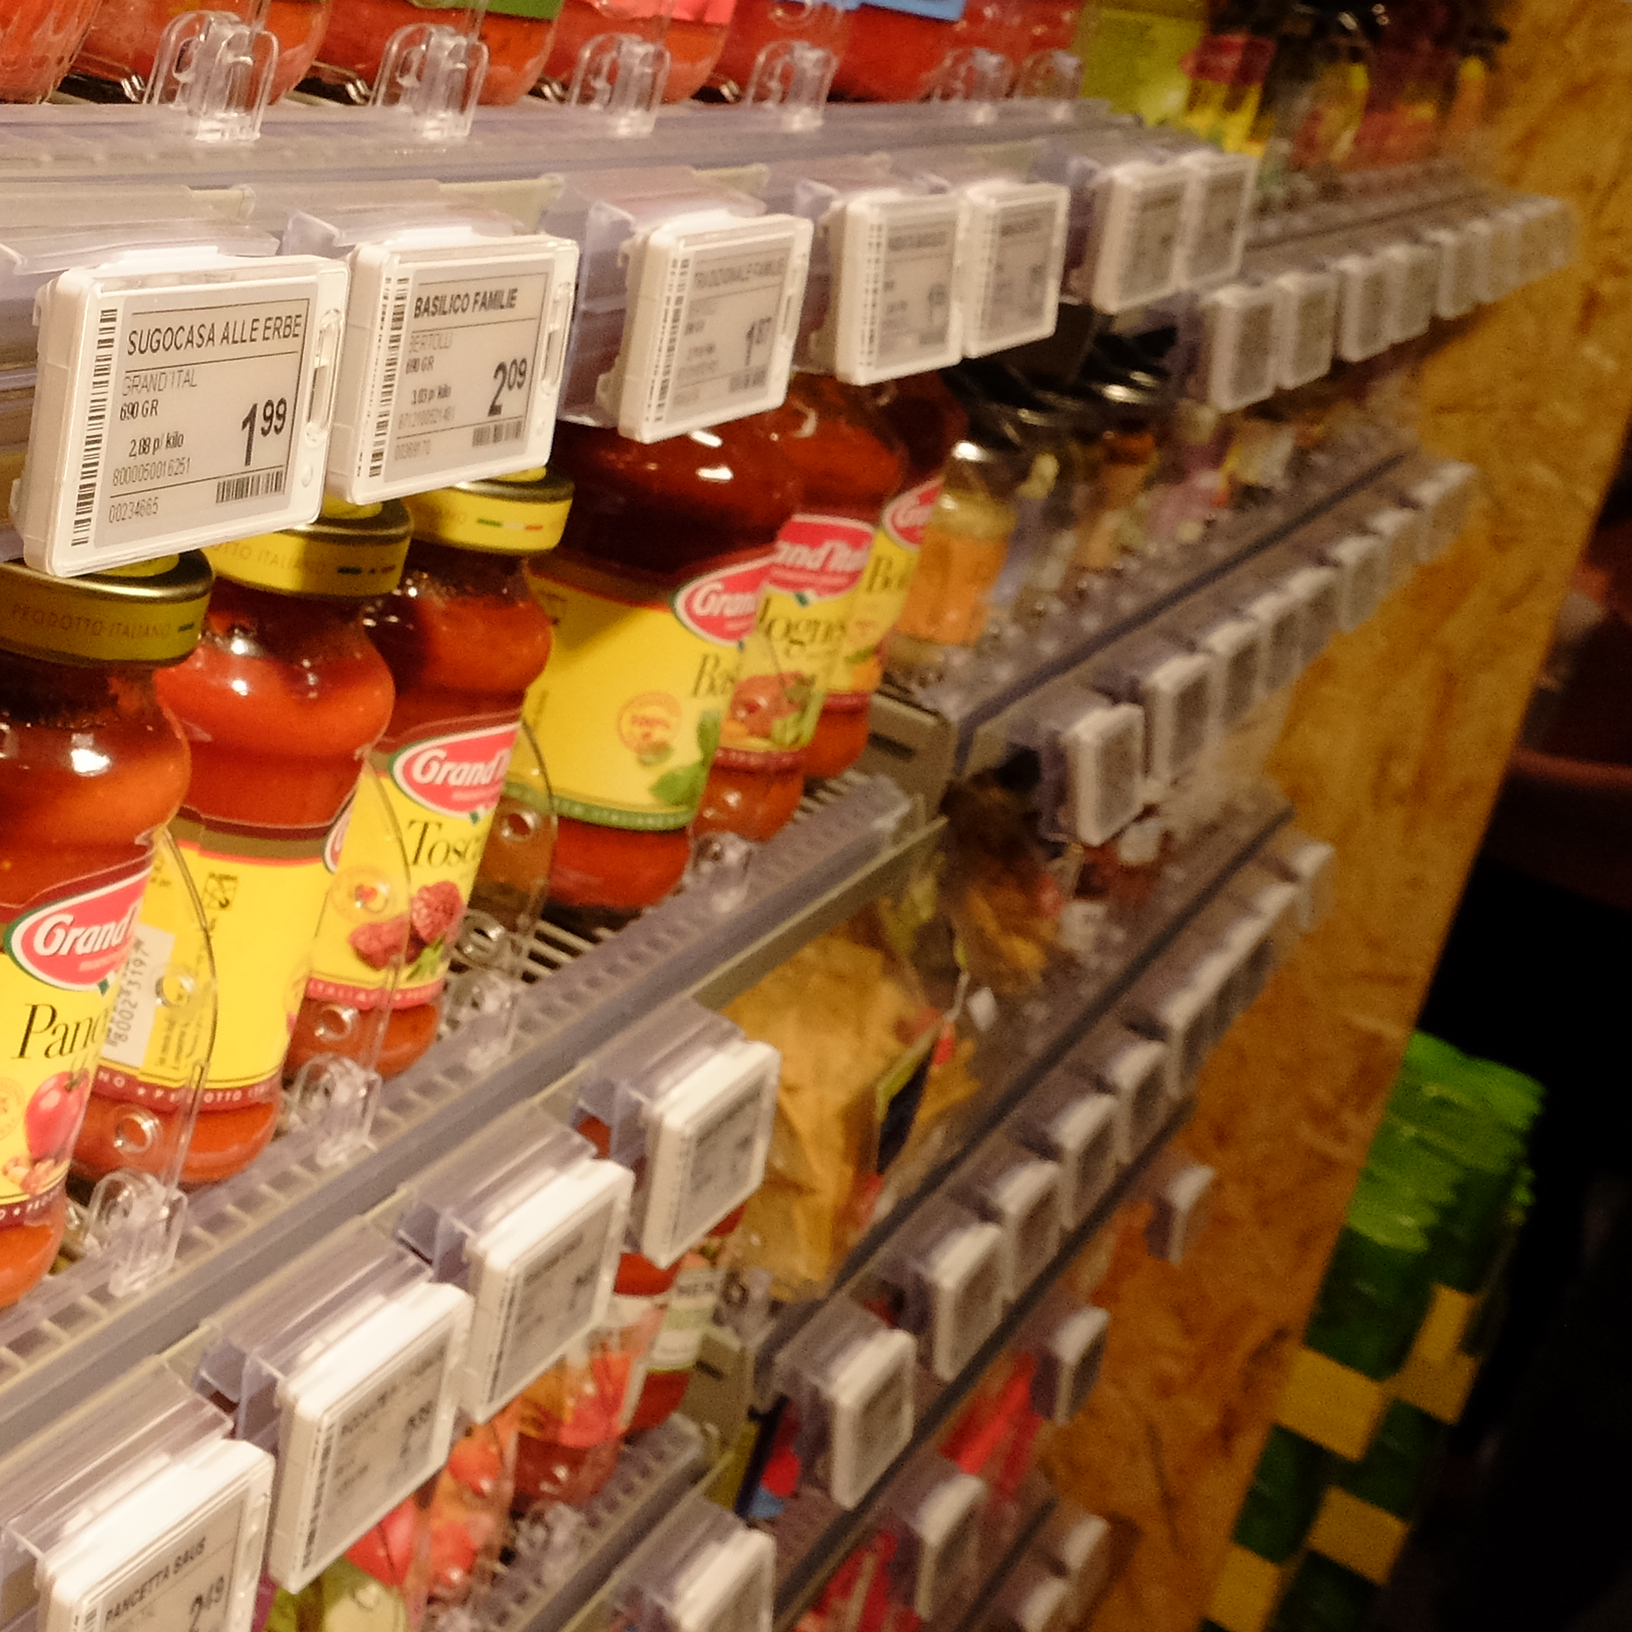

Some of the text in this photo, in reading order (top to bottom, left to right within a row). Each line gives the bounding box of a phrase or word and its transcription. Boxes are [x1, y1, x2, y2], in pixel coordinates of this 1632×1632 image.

[413, 292, 471, 320] BASILICO
[126, 313, 303, 357] SUGOCASA ALLE ERBE
[141, 398, 160, 417] GR
